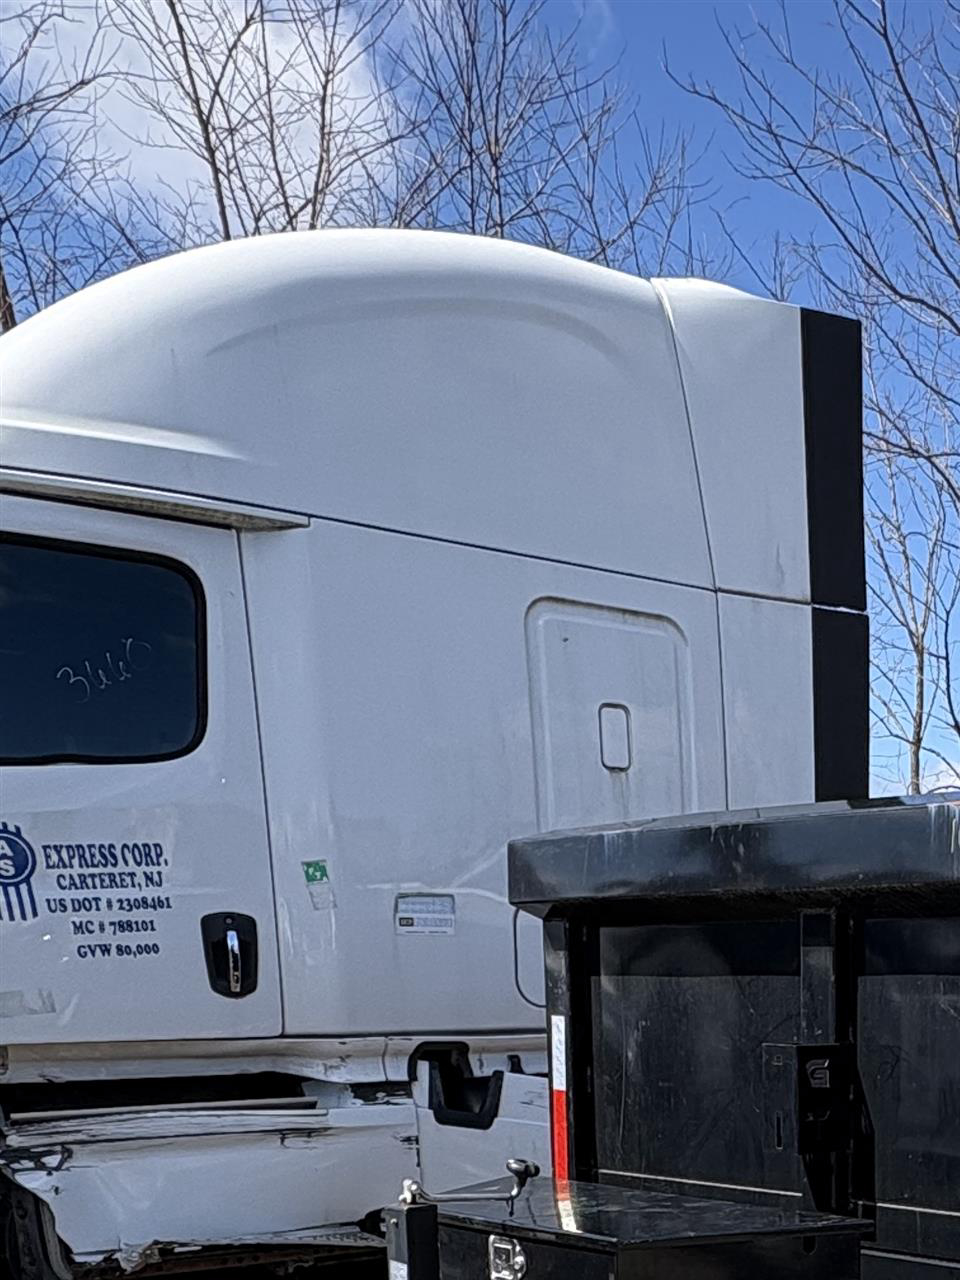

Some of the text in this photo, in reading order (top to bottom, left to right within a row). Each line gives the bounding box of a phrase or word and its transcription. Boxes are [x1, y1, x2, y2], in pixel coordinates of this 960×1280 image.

[42, 842, 168, 870] EXPRESS CORP.
[56, 871, 163, 892] CARTERET, NJ
[45, 898, 68, 913] US
[71, 897, 101, 912] DOT
[106, 898, 113, 911] #
[71, 920, 156, 935] MC # 788101
[77, 943, 160, 958] GVW 80,000
